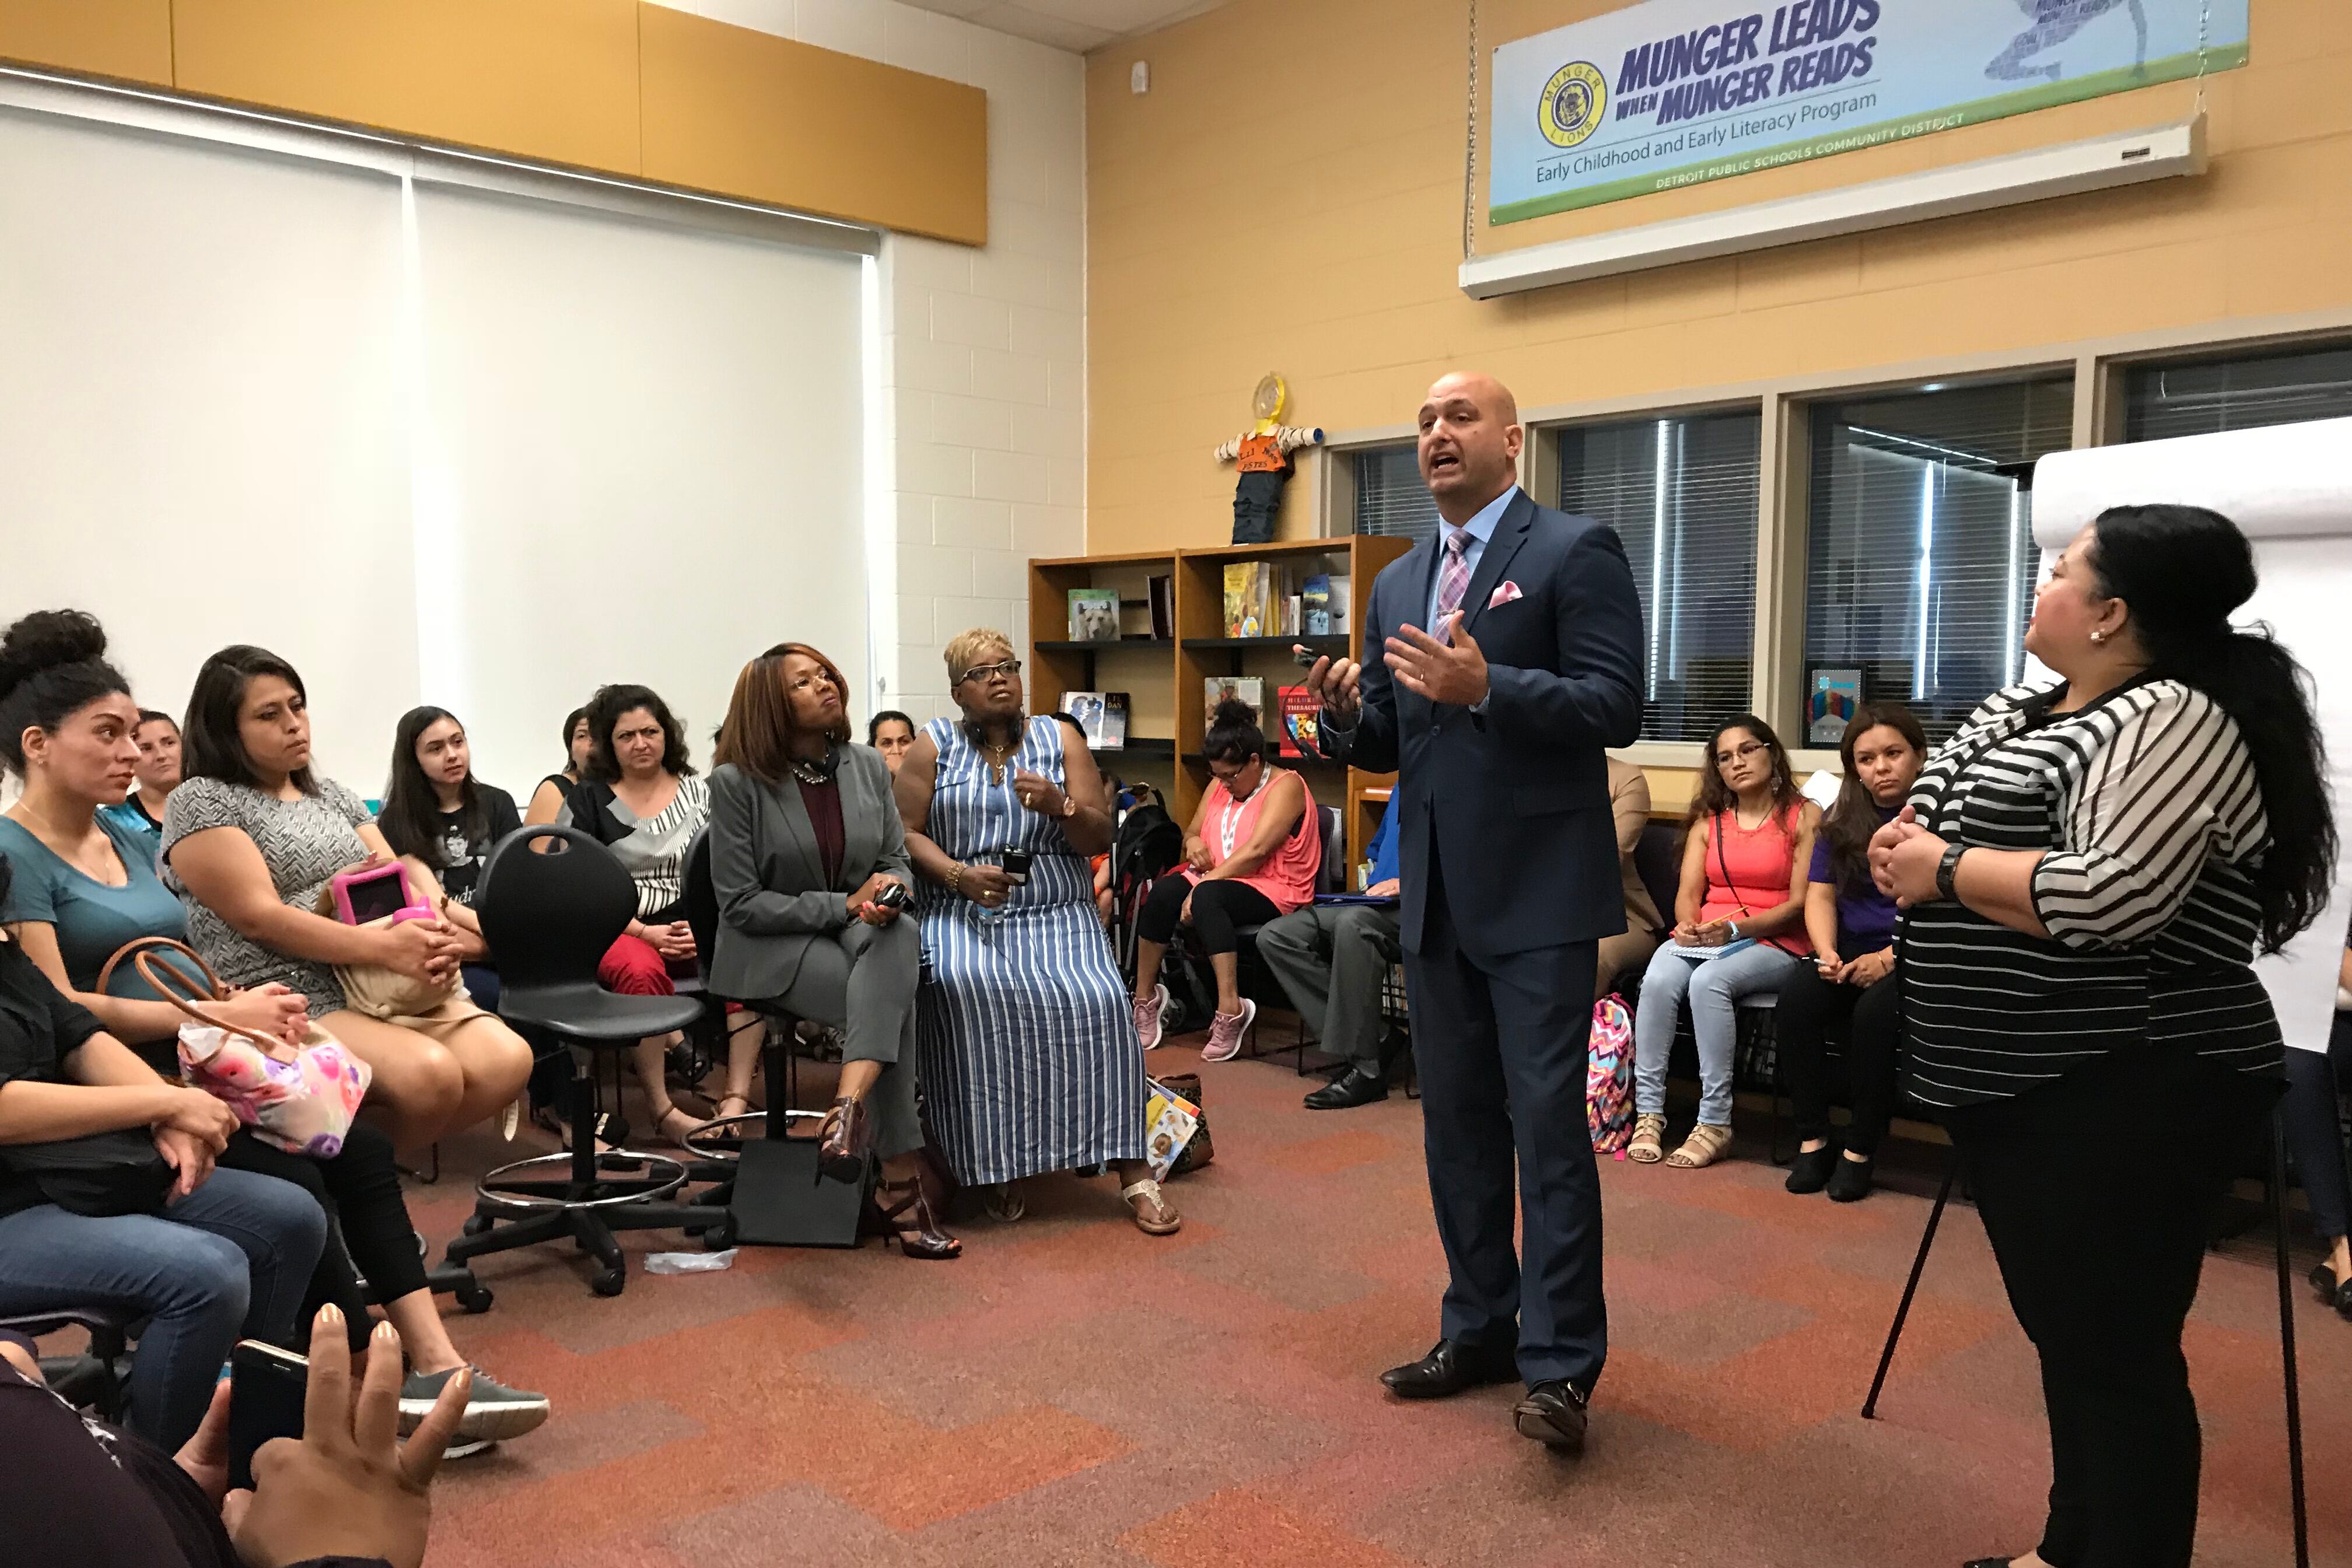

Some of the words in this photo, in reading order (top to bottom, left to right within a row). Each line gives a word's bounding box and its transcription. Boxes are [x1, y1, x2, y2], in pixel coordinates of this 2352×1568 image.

[1545, 66, 1601, 102] MUNGER
[1615, 92, 1658, 121] WHEN
[1657, 62, 1774, 125] MUNGER
[1777, 36, 1877, 96] READS
[1616, 14, 1763, 96] MUNGER
[1768, 0, 1881, 56] LEADS
[1536, 162, 1570, 183] Early
[1574, 142, 1650, 174] Childhood
[1654, 135, 1684, 158] and
[1689, 126, 1727, 149] Early
[1731, 111, 1797, 139] Literacy
[1801, 93, 1877, 123] Program
[1550, 121, 1593, 142] LIONS
[1656, 170, 1704, 188] DETROIT
[1709, 161, 1751, 177] PUBLIC
[1754, 147, 1812, 167] SCHOOLS
[1816, 128, 1897, 154] COMMUNITY
[1902, 113, 1964, 136] DISTRICT
